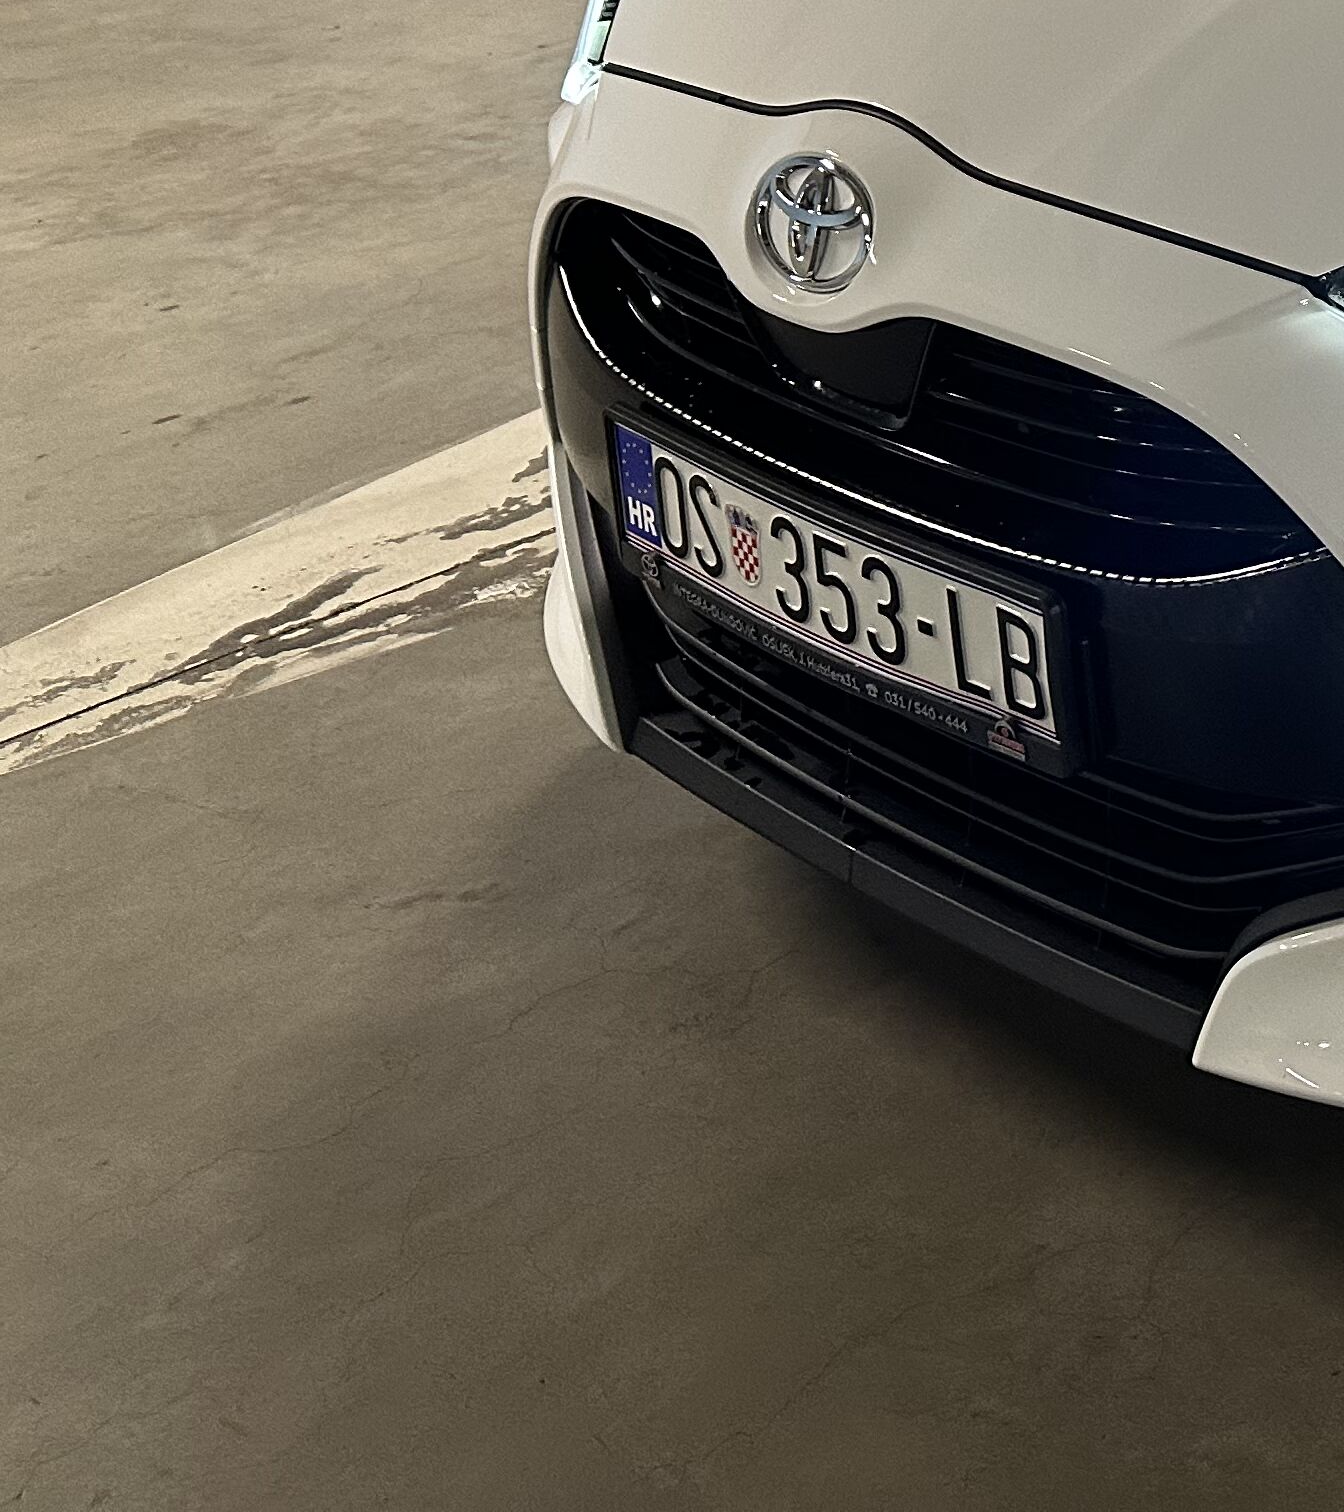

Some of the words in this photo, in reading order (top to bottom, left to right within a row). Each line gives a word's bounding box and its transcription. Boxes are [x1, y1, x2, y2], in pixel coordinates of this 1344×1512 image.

[627, 496, 658, 537] HR
[654, 456, 724, 579] OS
[770, 515, 1046, 721] 353-LB
